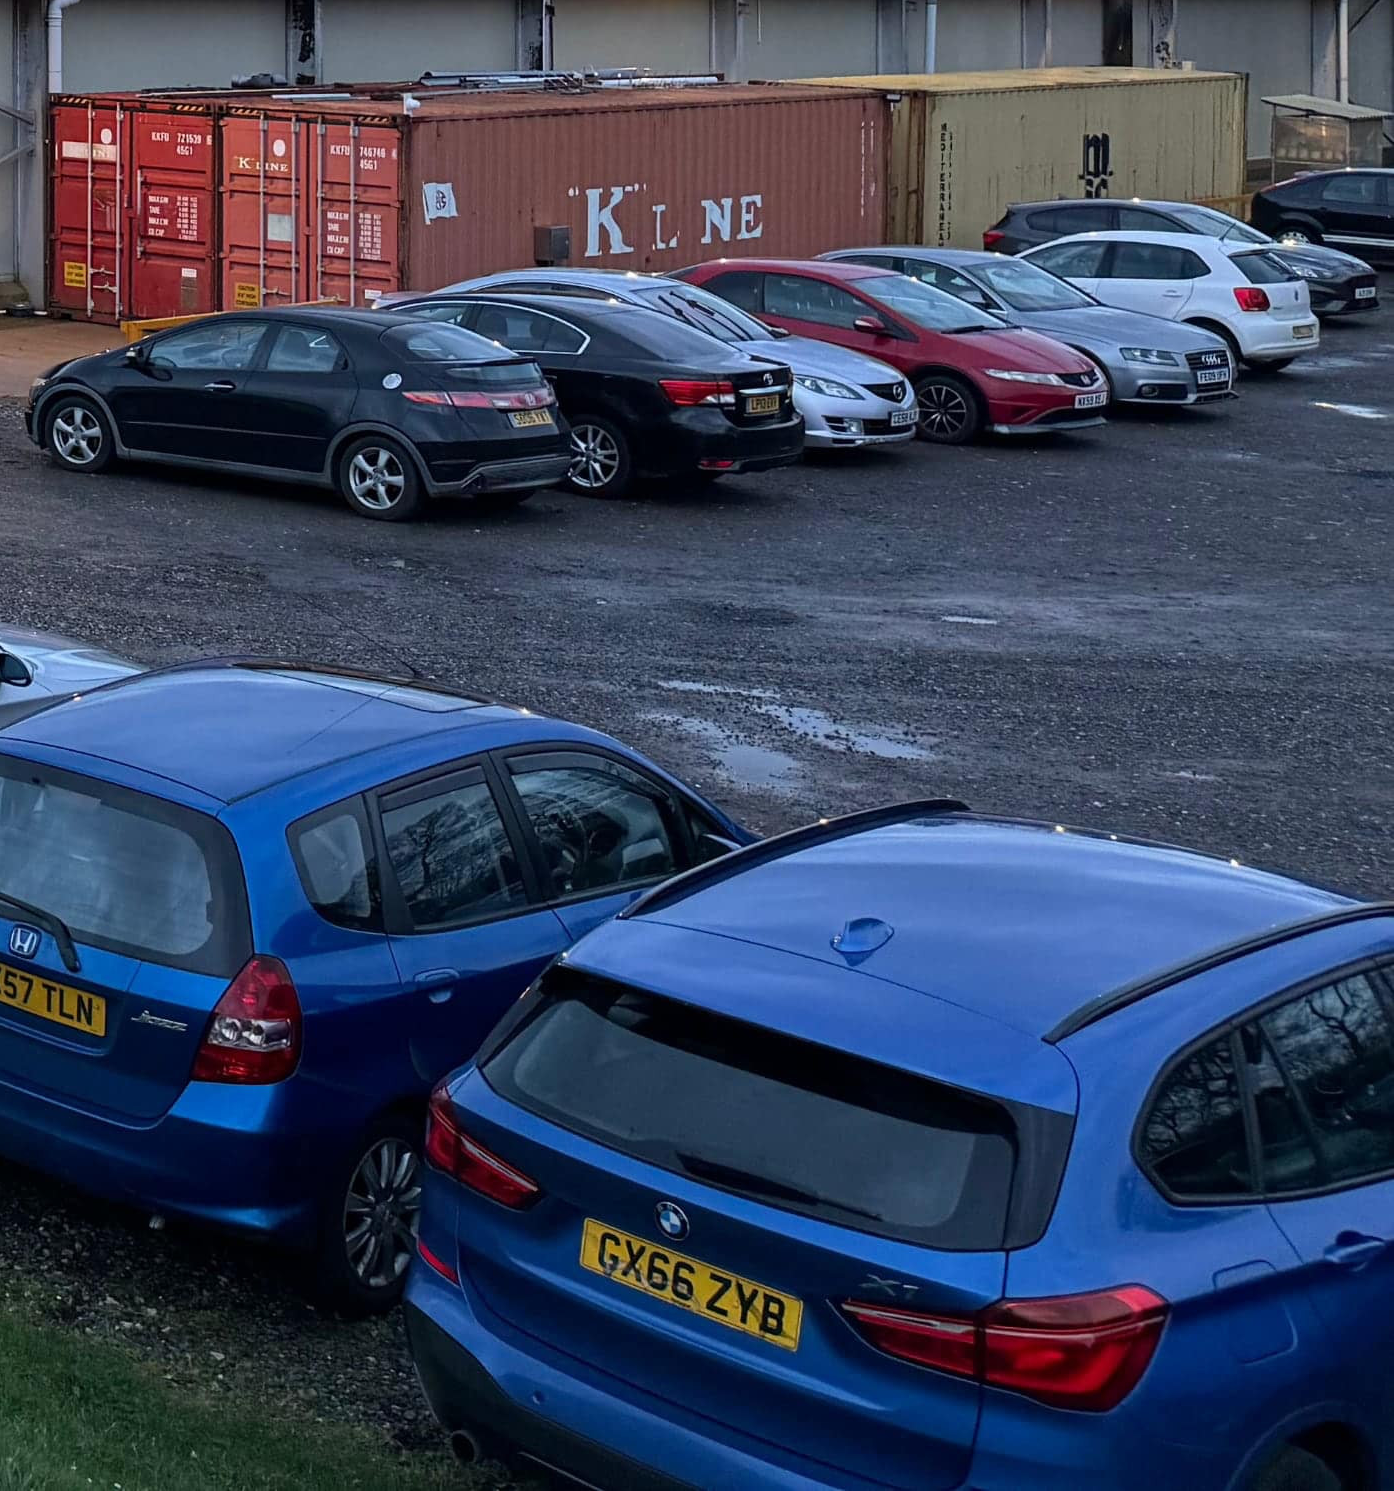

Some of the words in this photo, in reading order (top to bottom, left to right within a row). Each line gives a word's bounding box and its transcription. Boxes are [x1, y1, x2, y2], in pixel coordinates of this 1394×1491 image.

[42, 983, 93, 1027] TLN
[597, 1231, 696, 1302] GX66
[704, 1273, 787, 1337] ZYB
